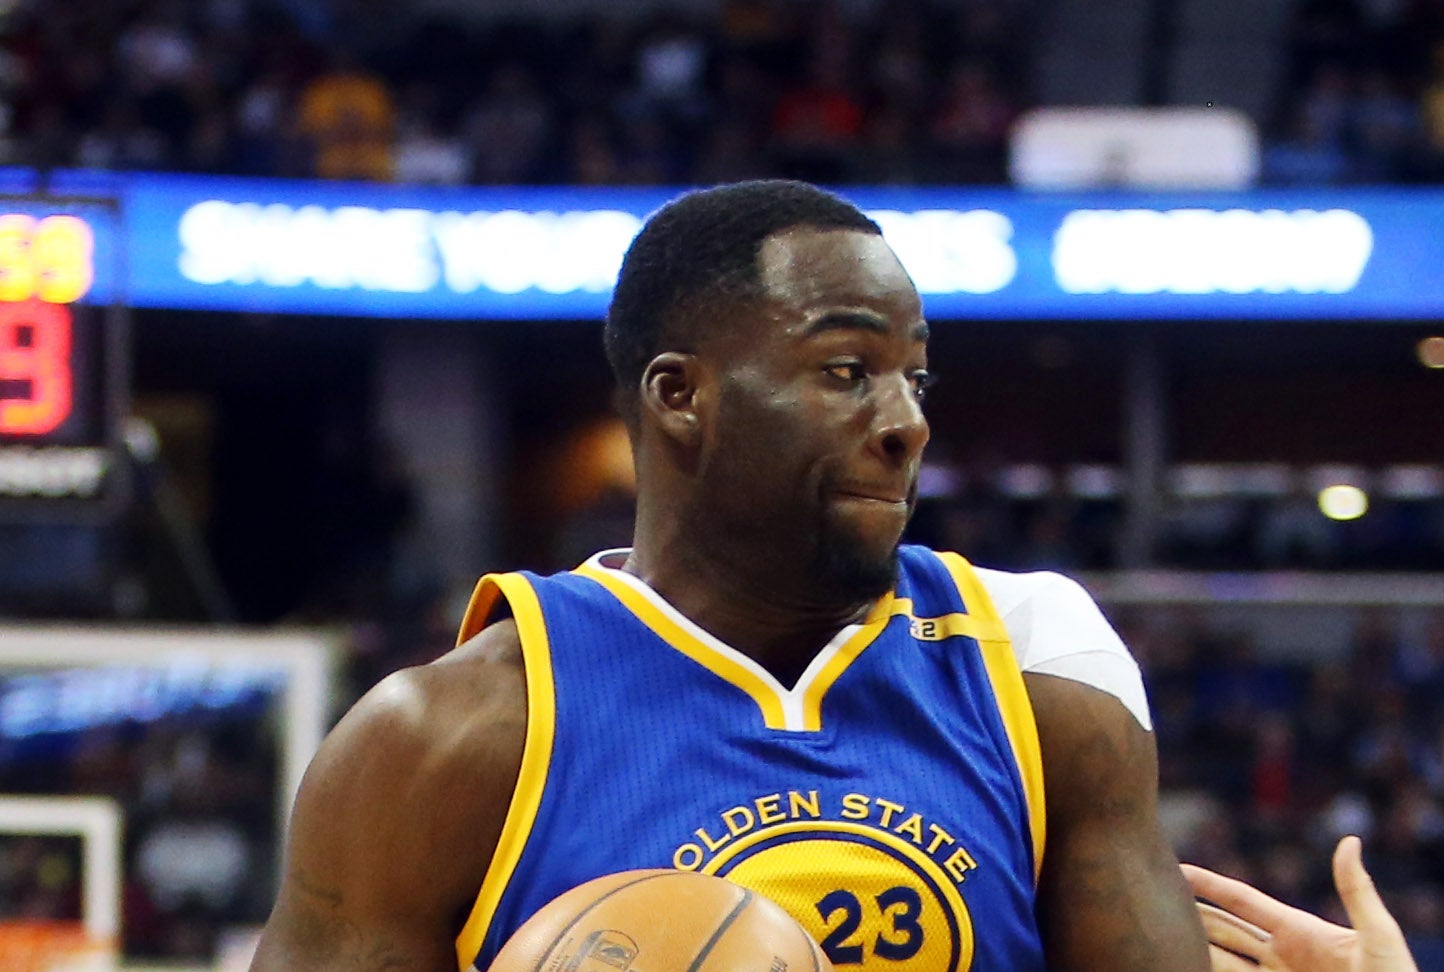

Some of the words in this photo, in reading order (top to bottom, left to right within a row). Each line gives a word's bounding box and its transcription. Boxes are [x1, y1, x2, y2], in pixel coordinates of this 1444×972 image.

[672, 789, 822, 872] OLDEN
[840, 792, 979, 884] STATE
[814, 885, 926, 967] 23
